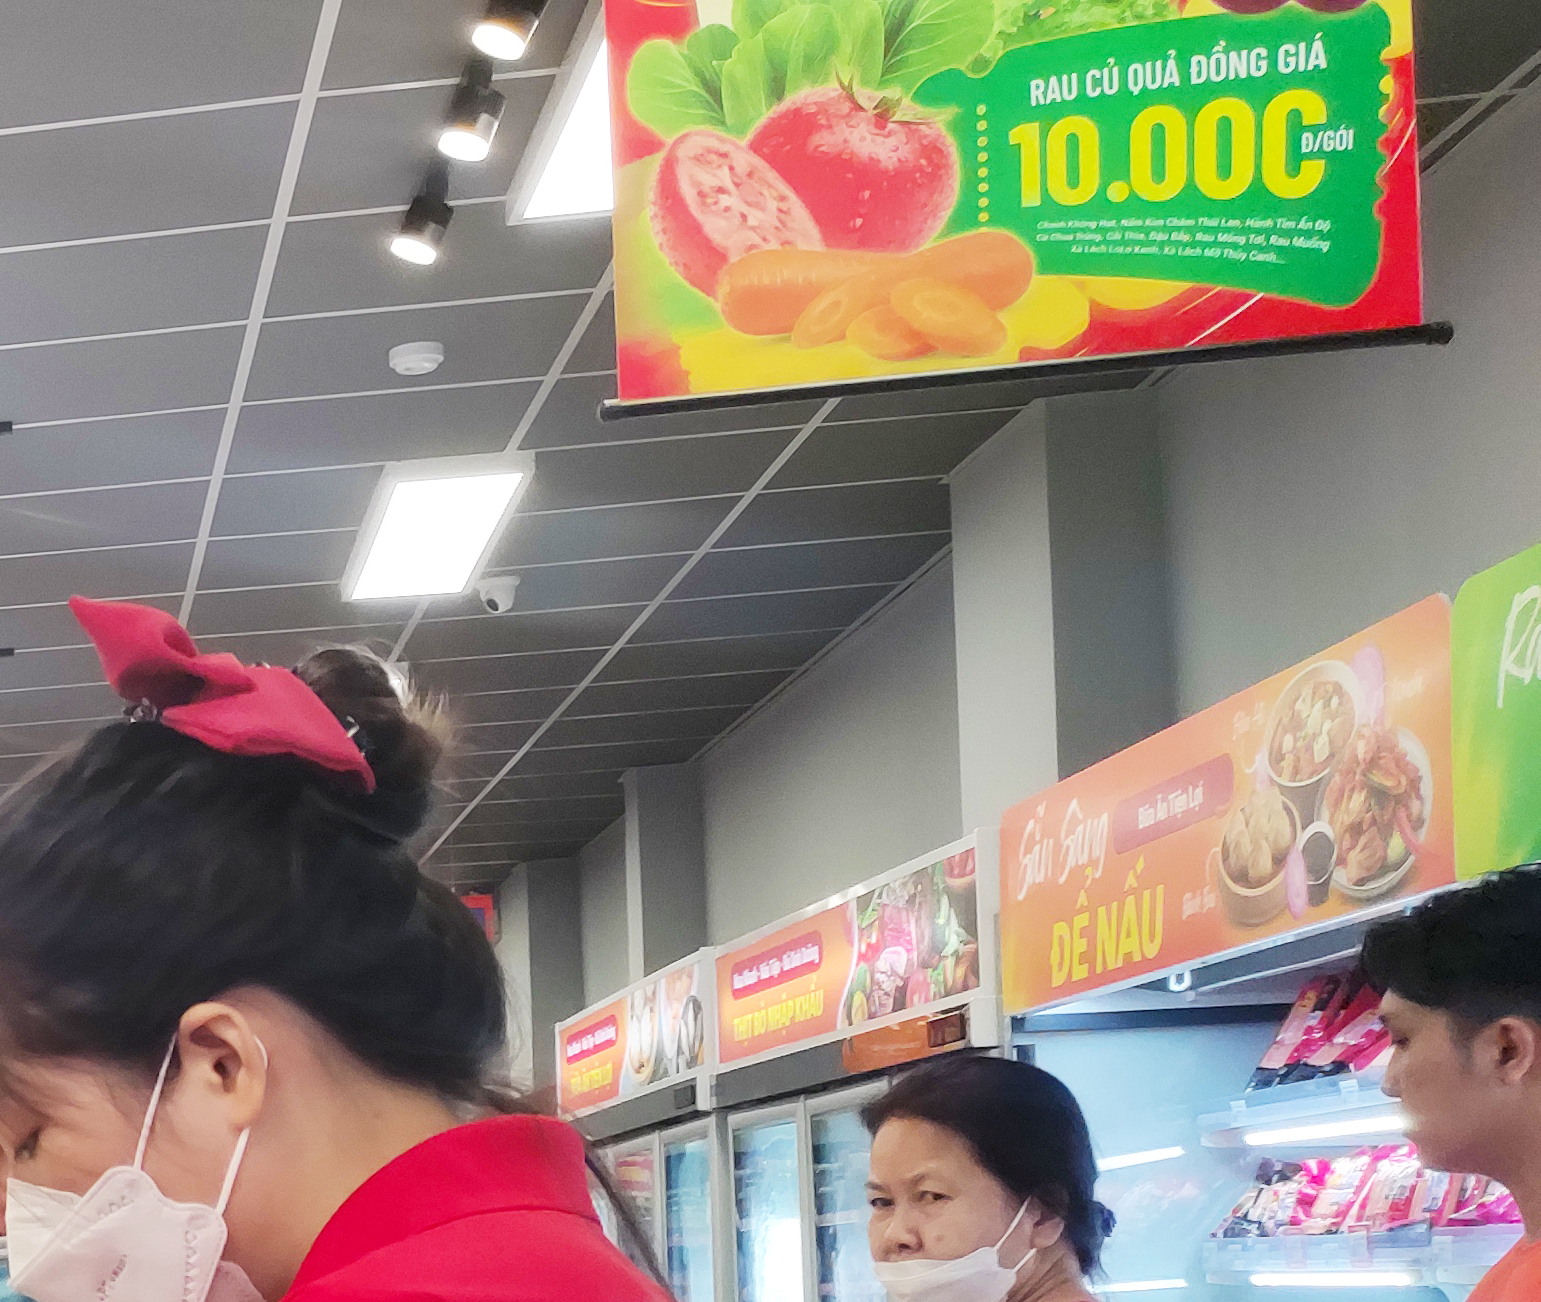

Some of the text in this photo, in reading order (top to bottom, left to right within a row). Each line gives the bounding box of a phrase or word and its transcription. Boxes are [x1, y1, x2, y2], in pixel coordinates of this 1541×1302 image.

[1030, 73, 1078, 106] RAU
[1086, 57, 1119, 97] CỦ
[1127, 50, 1180, 95] QUẢ
[1277, 32, 1327, 75] GIÁ
[1049, 855, 1165, 988] ĐỂ NẤU
